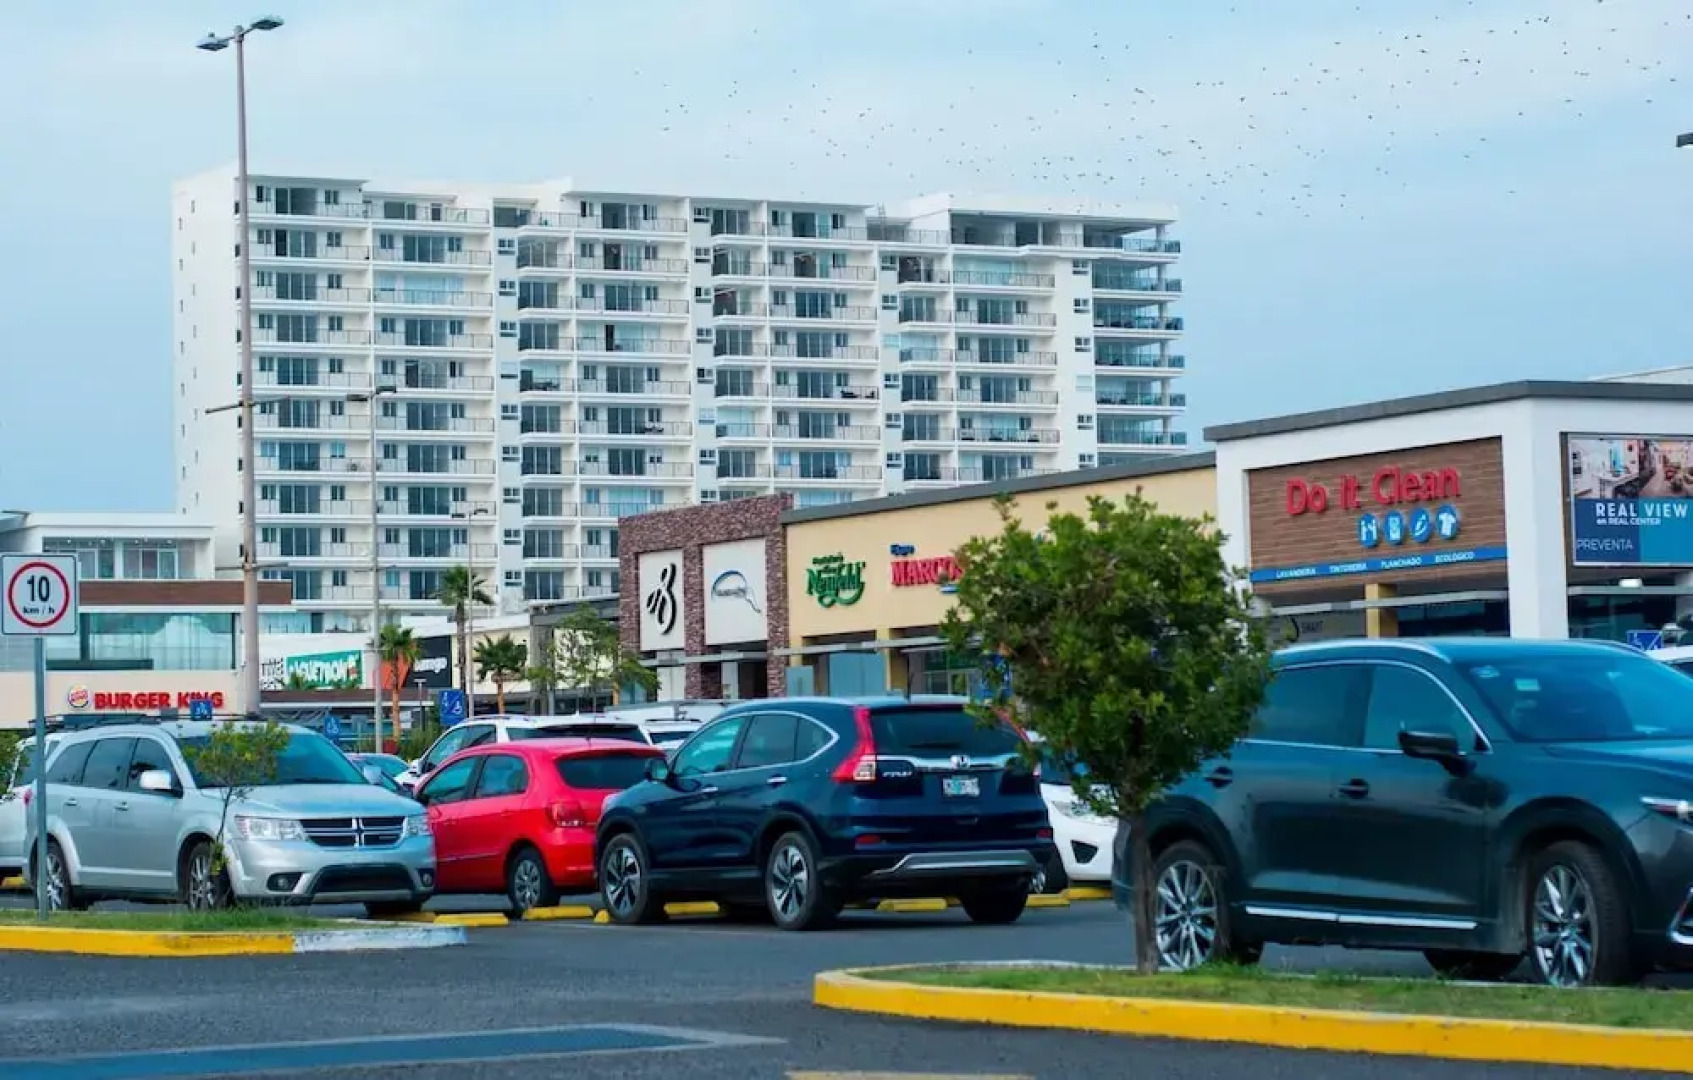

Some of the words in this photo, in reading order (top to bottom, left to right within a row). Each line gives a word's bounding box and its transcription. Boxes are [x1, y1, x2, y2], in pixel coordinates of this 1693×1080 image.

[1286, 478, 1328, 515] Do
[1373, 465, 1462, 506] Clean
[1595, 502, 1638, 518] REAL
[1643, 502, 1689, 518] VIEW
[1608, 517, 1629, 526] REAL
[1630, 517, 1662, 526] CENTER
[1577, 538, 1634, 551] PREVENTA
[27, 575, 50, 602] 10
[94, 691, 170, 709] BURGER
